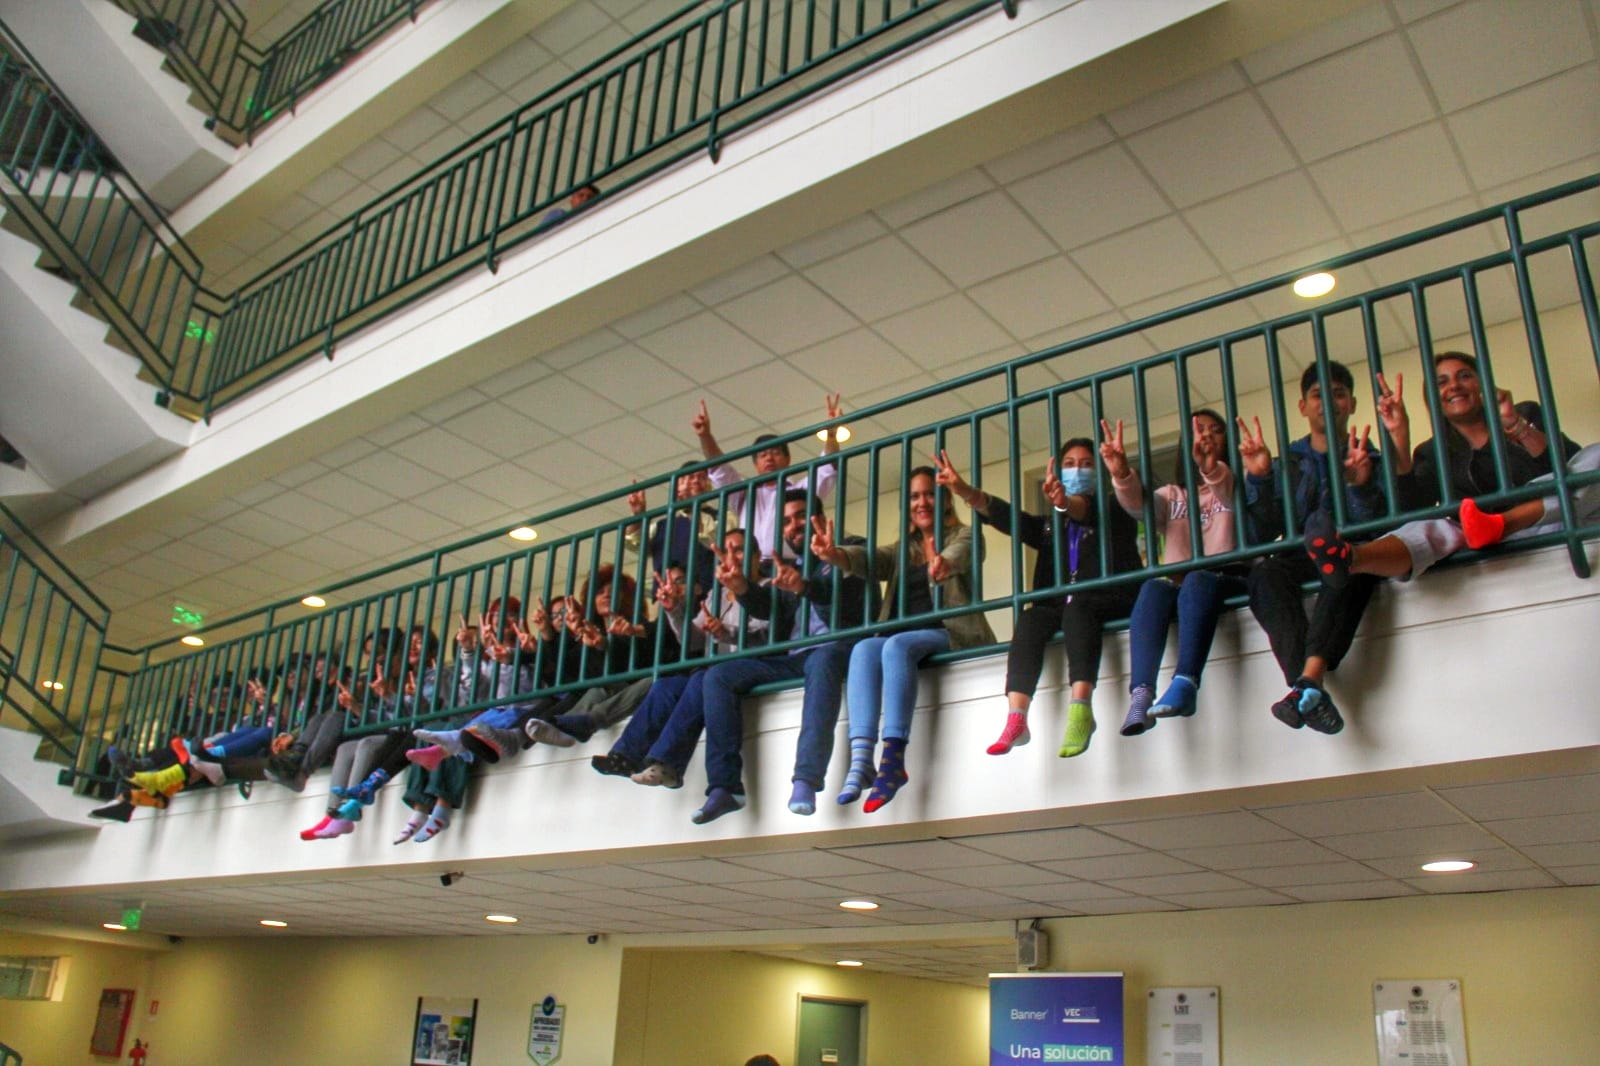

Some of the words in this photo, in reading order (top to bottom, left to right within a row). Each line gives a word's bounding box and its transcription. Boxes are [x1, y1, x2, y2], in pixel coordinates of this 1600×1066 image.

[1011, 1009, 1047, 1020] Banner
[1010, 1044, 1041, 1059] Una
[1044, 1045, 1111, 1061] solución
